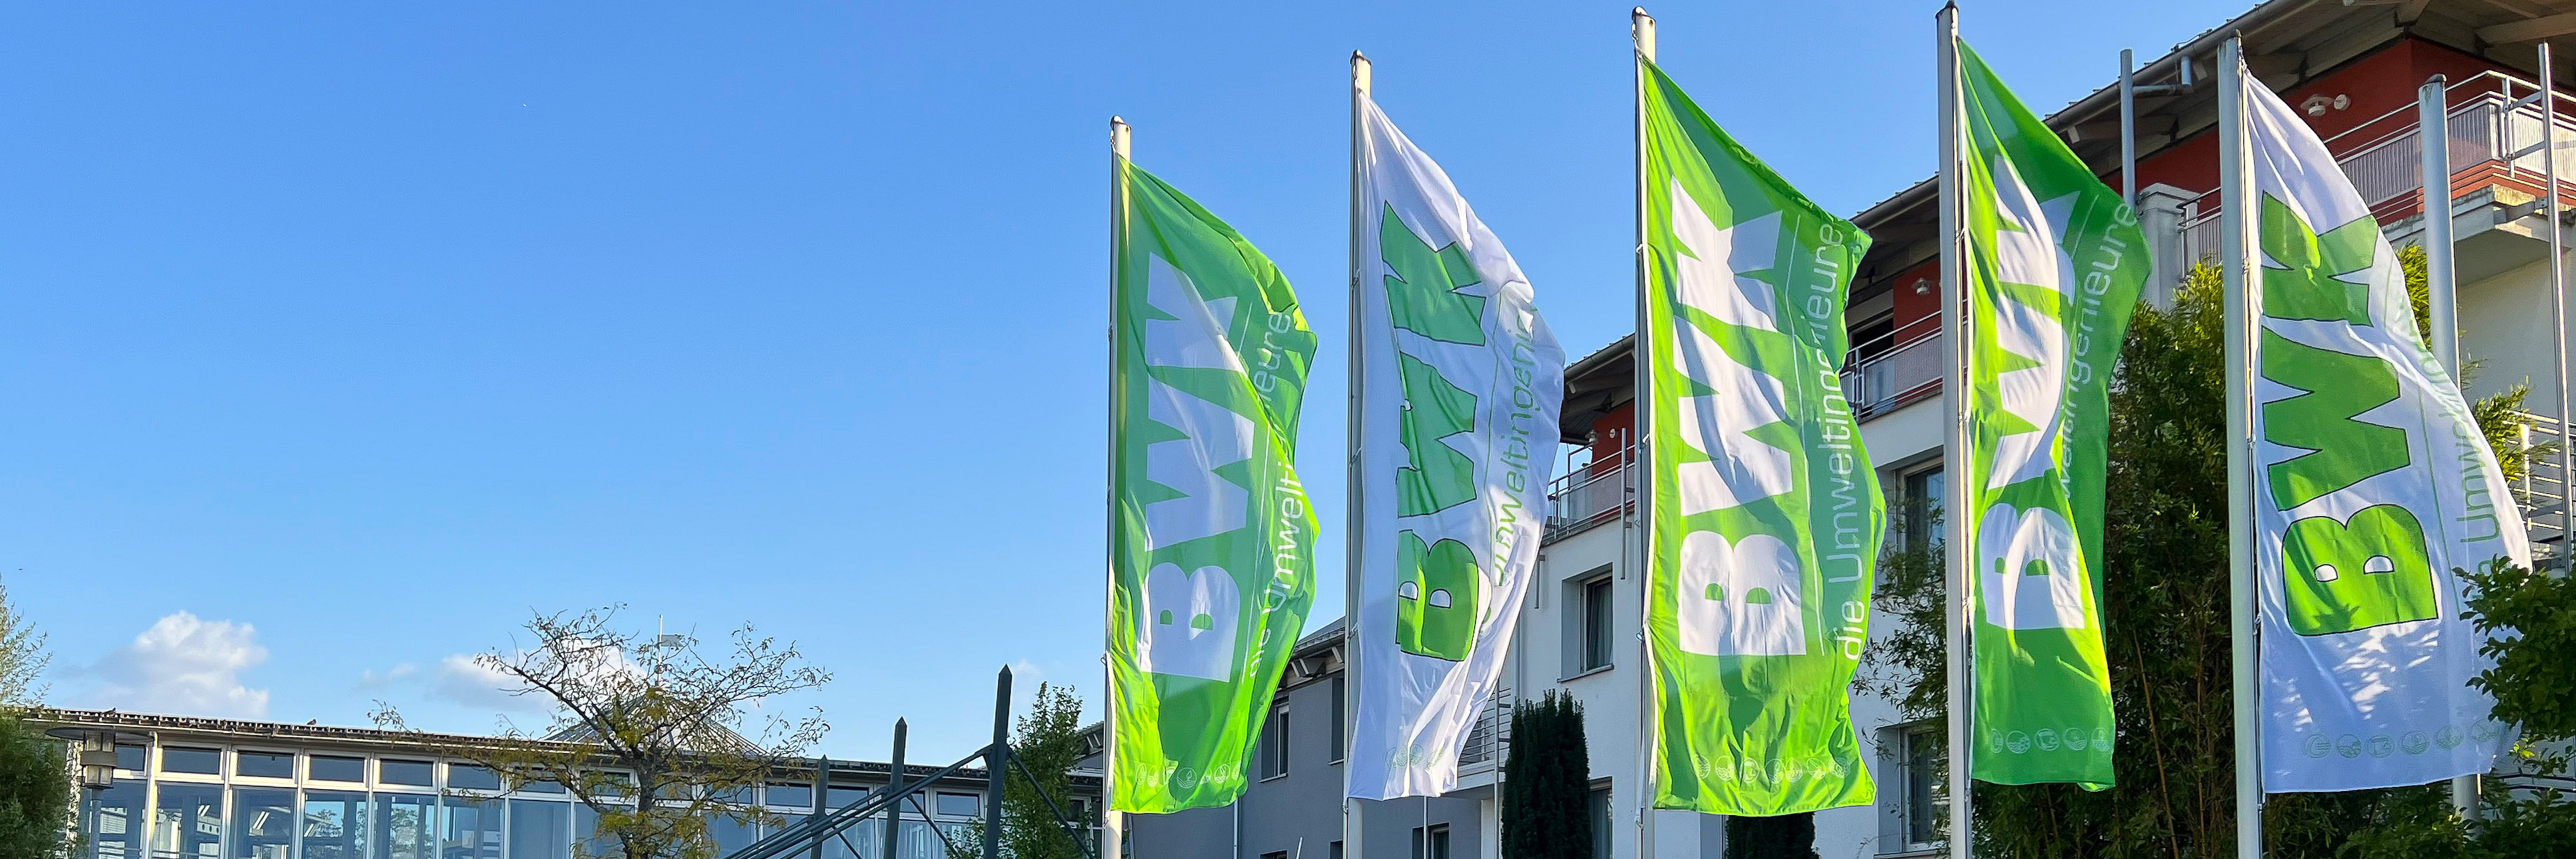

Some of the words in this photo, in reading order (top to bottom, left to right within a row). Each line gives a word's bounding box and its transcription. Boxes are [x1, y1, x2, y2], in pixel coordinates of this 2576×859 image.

[1137, 252, 1255, 683] BWK
[1254, 312, 1303, 615] Umweltiieure
[1381, 200, 1485, 661] BWK
[1494, 307, 1540, 587] Umweltingeni
[1671, 174, 1807, 656] BWK
[1978, 154, 2085, 630] BWK
[2061, 202, 2137, 499] weltingenieure
[2261, 190, 2438, 636] BWK
[1833, 601, 1864, 661] die
